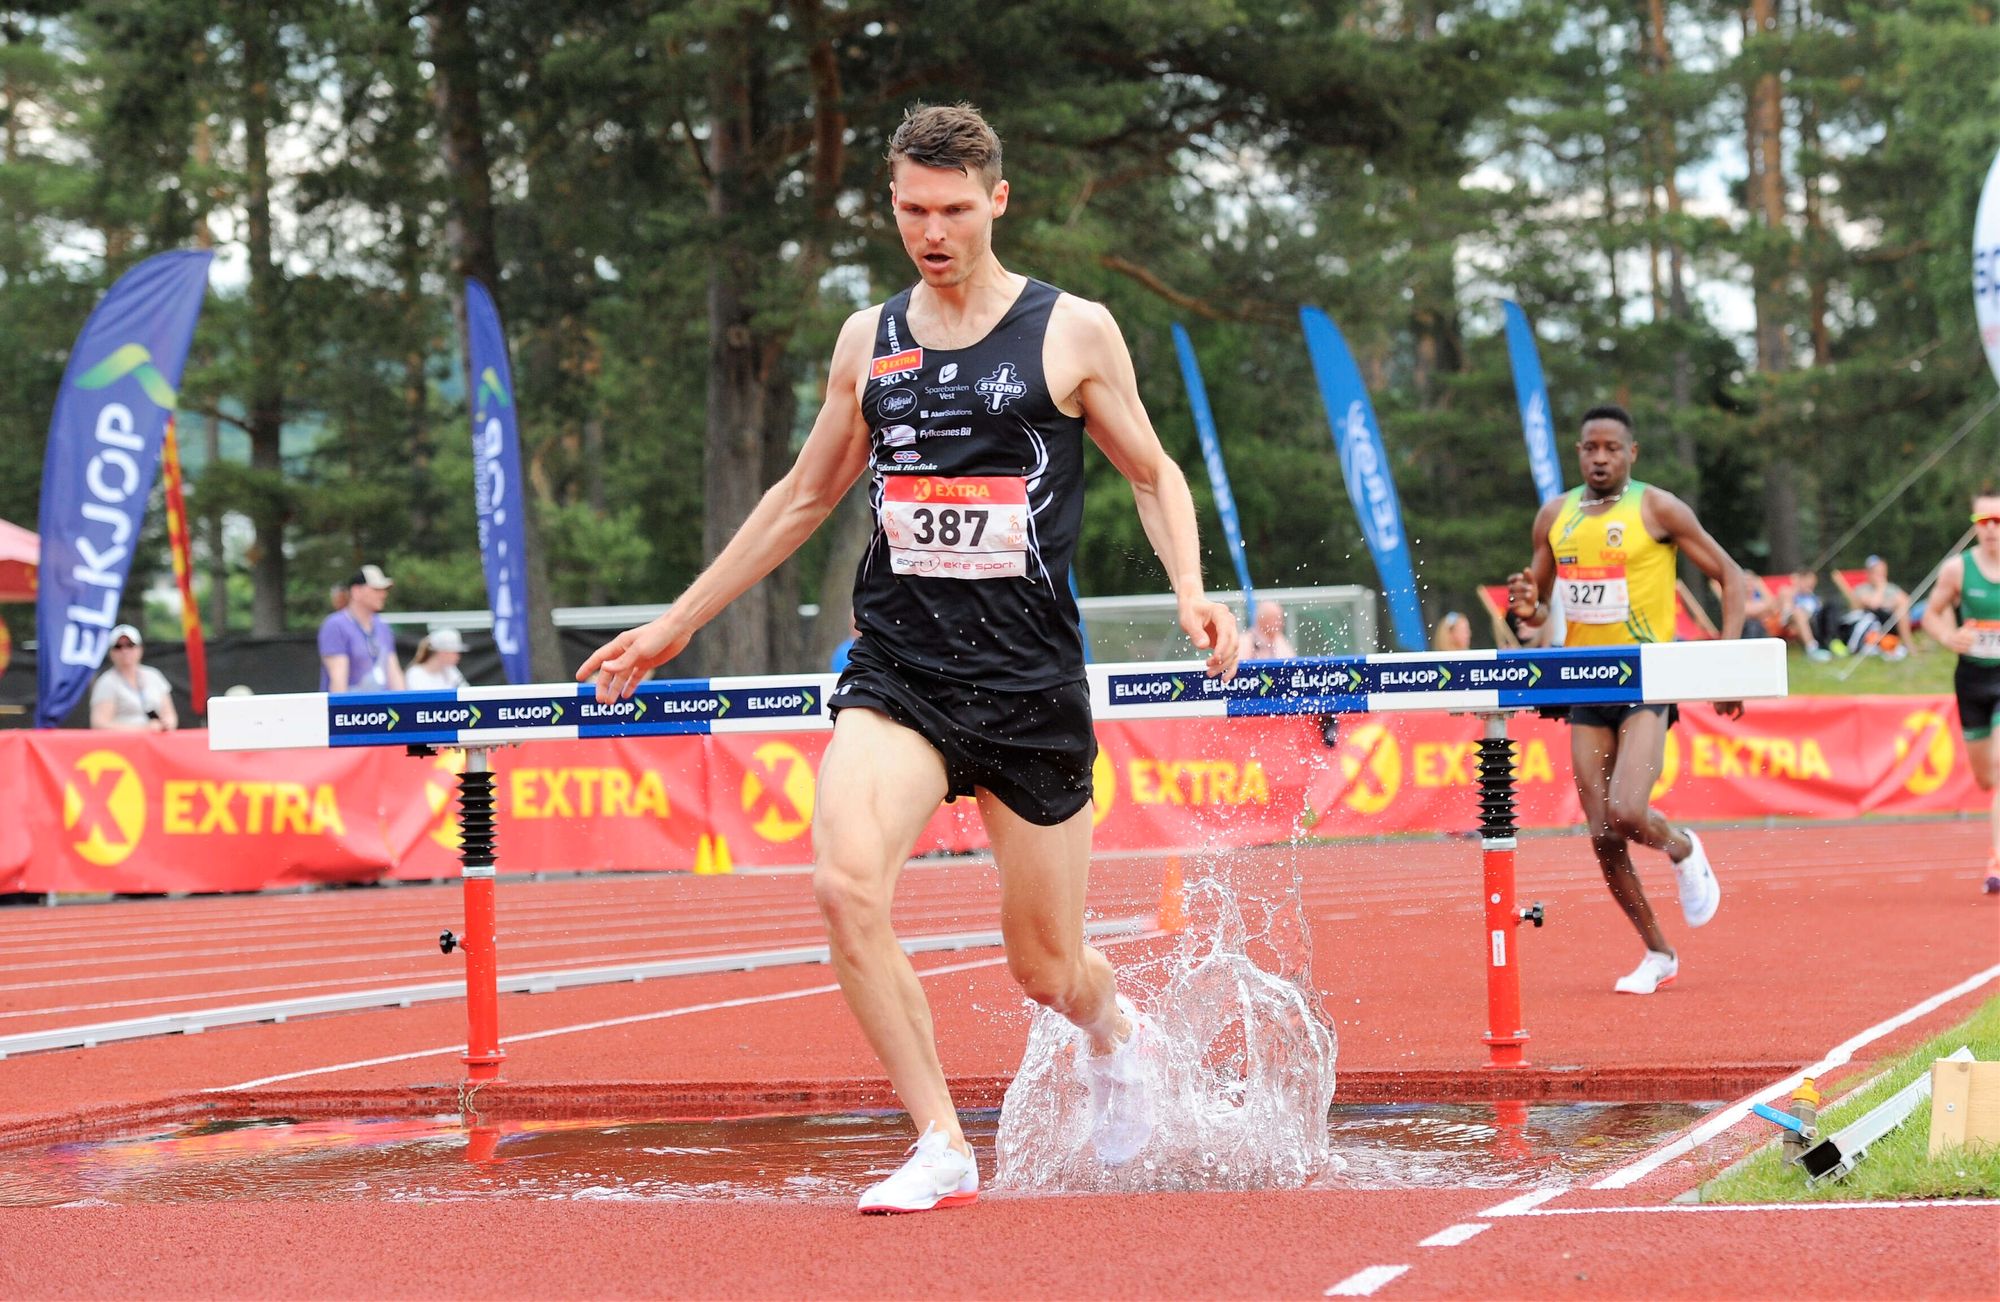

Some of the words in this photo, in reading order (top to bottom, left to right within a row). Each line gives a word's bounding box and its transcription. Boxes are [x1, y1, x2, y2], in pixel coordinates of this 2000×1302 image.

[886, 315, 901, 354] TRIMTEX
[925, 384, 970, 395] Sparebanken
[979, 382, 1023, 394] STORD
[920, 429, 960, 439] Fylkesnes
[961, 427, 972, 436] Bil
[936, 484, 990, 498] EXTRA
[913, 508, 989, 546] 387
[1569, 585, 1605, 604] 327
[1413, 739, 1555, 788] EXA
[1691, 734, 1833, 781] EXTRA
[510, 768, 671, 819] EXTRA
[1129, 760, 1270, 806] EXTRA
[163, 780, 347, 835] EXTRA
